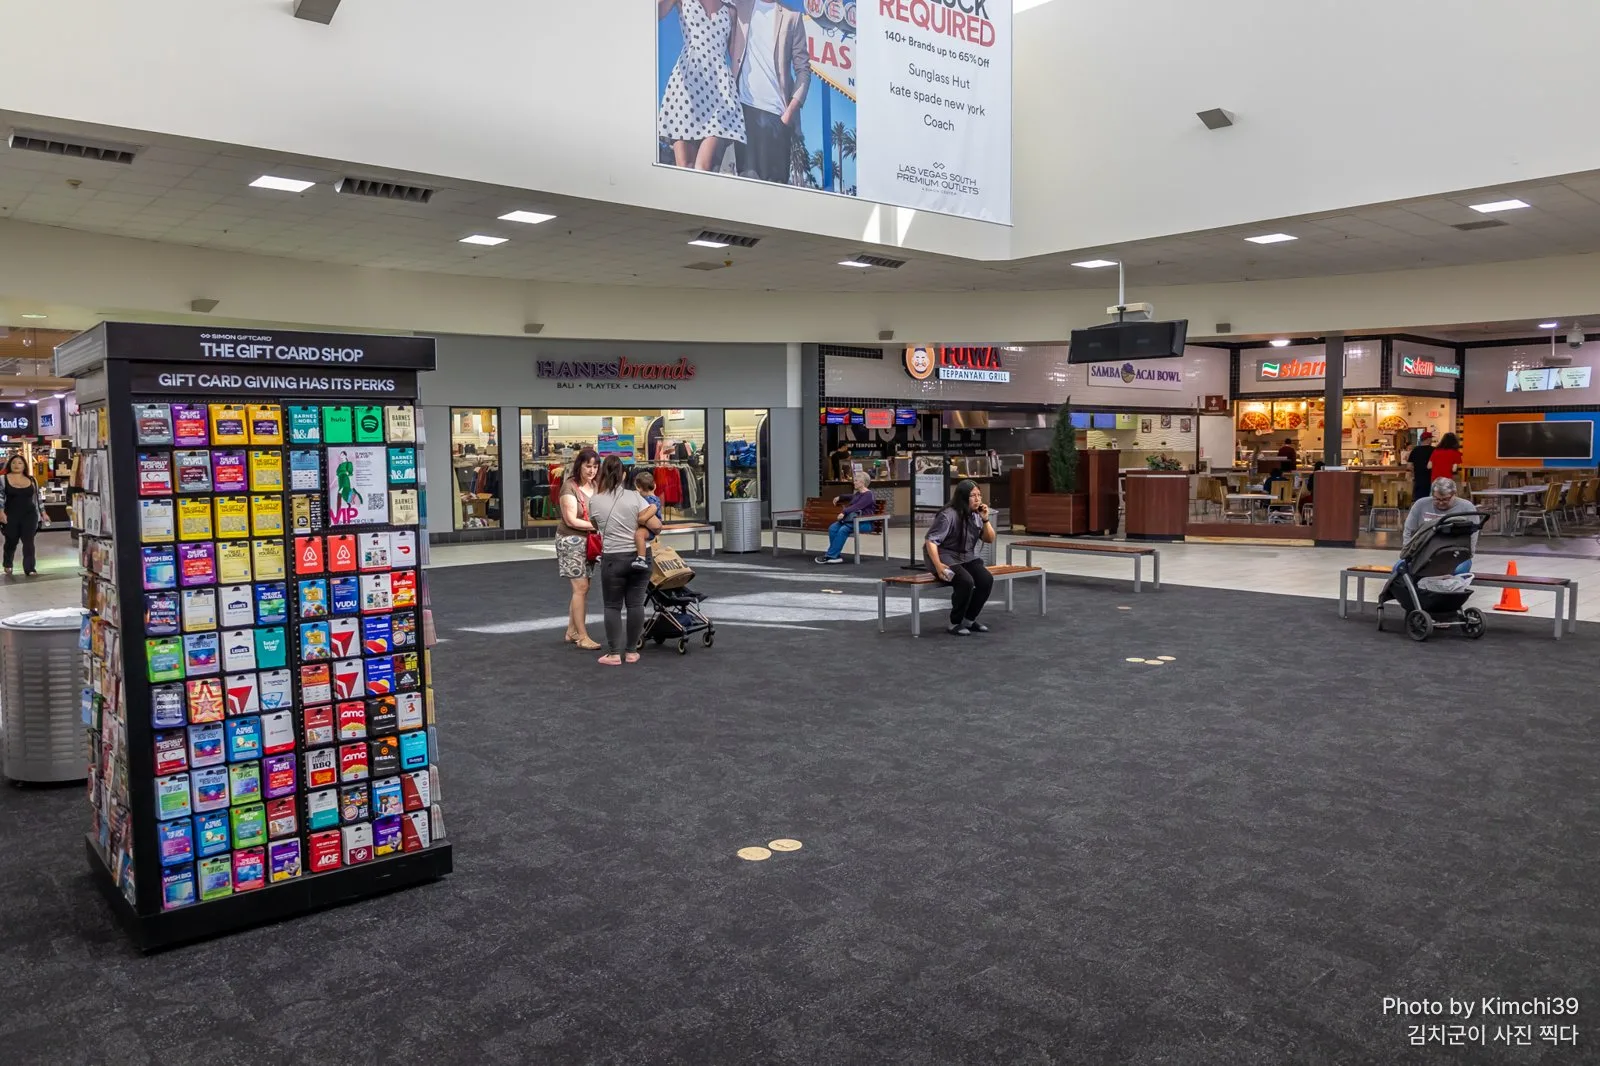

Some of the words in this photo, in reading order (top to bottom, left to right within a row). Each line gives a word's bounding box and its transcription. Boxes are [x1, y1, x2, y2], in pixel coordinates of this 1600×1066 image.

[880, 0, 996, 48] REQUIRED
[808, 36, 852, 70] LAS
[885, 30, 906, 43] 140+
[909, 36, 936, 54] Brands
[937, 45, 948, 57] up
[949, 49, 958, 58] to
[958, 51, 977, 64] 65%
[978, 56, 990, 68] Off
[908, 63, 950, 85] Sunglass
[952, 75, 970, 90] Hut
[890, 82, 911, 98] kate
[914, 91, 942, 106] spade
[944, 98, 964, 110] new
[967, 105, 986, 116] york
[924, 114, 954, 131] Coach
[898, 163, 916, 175] LAS
[918, 168, 948, 180] VEGAS
[949, 173, 976, 186] SOUTH
[896, 172, 939, 188] PREMIUM
[941, 180, 980, 196] OUTLETS
[200, 342, 234, 358] THE
[236, 344, 274, 359] GIFT
[275, 347, 320, 360] CARD
[321, 348, 364, 362] SHOP
[942, 370, 986, 379] TEPPANYAKI
[989, 372, 1007, 382] GRILL
[1091, 366, 1121, 378] SAMBA
[1136, 369, 1156, 380] ACAI
[1157, 370, 1182, 383] BOWL
[1280, 358, 1326, 378] sbarr
[158, 374, 195, 387] GIFT
[198, 374, 242, 388] CARD
[244, 376, 297, 389] GIVING
[300, 376, 328, 390] HAS
[331, 377, 352, 390] ITS
[354, 378, 396, 392] PERKS
[329, 508, 358, 525] VIP
[335, 600, 357, 608] VUDU
[341, 710, 364, 718] amc
[312, 761, 331, 769] BBQ
[344, 752, 366, 762] amc
[318, 854, 338, 865] ACE
[164, 874, 178, 883] WISH
[179, 872, 192, 880] BIG
